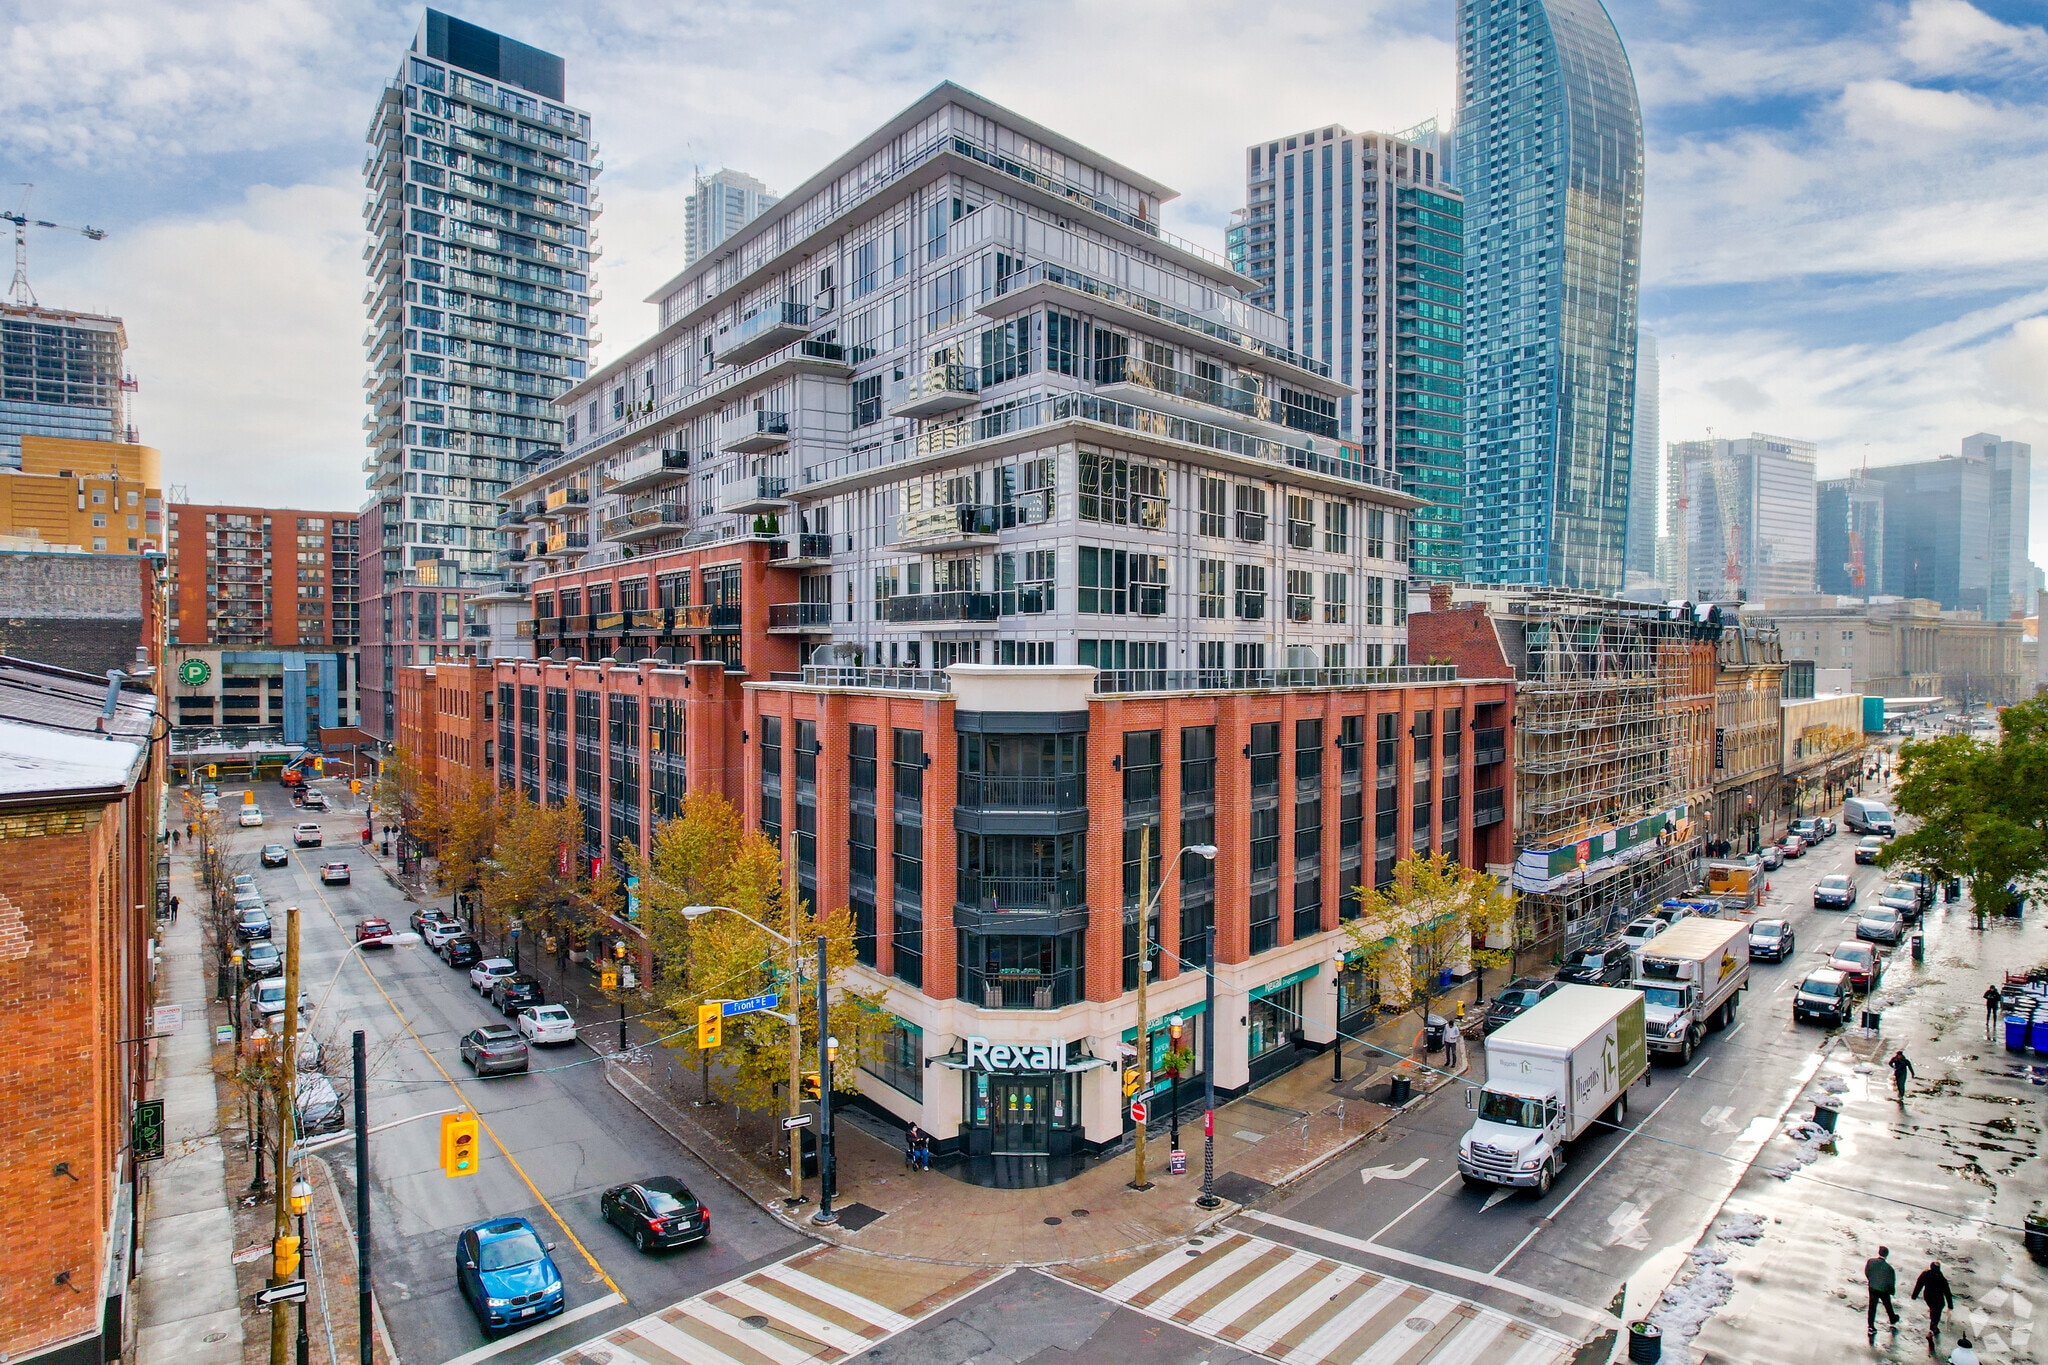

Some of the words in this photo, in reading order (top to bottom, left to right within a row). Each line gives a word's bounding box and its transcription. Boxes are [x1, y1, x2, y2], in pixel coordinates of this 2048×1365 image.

[734, 1000, 754, 1011] Front
[761, 997, 767, 1006] E
[1146, 1016, 1163, 1030] exall
[968, 1035, 1067, 1071] Rexall
[1154, 1043, 1170, 1053] OPEN
